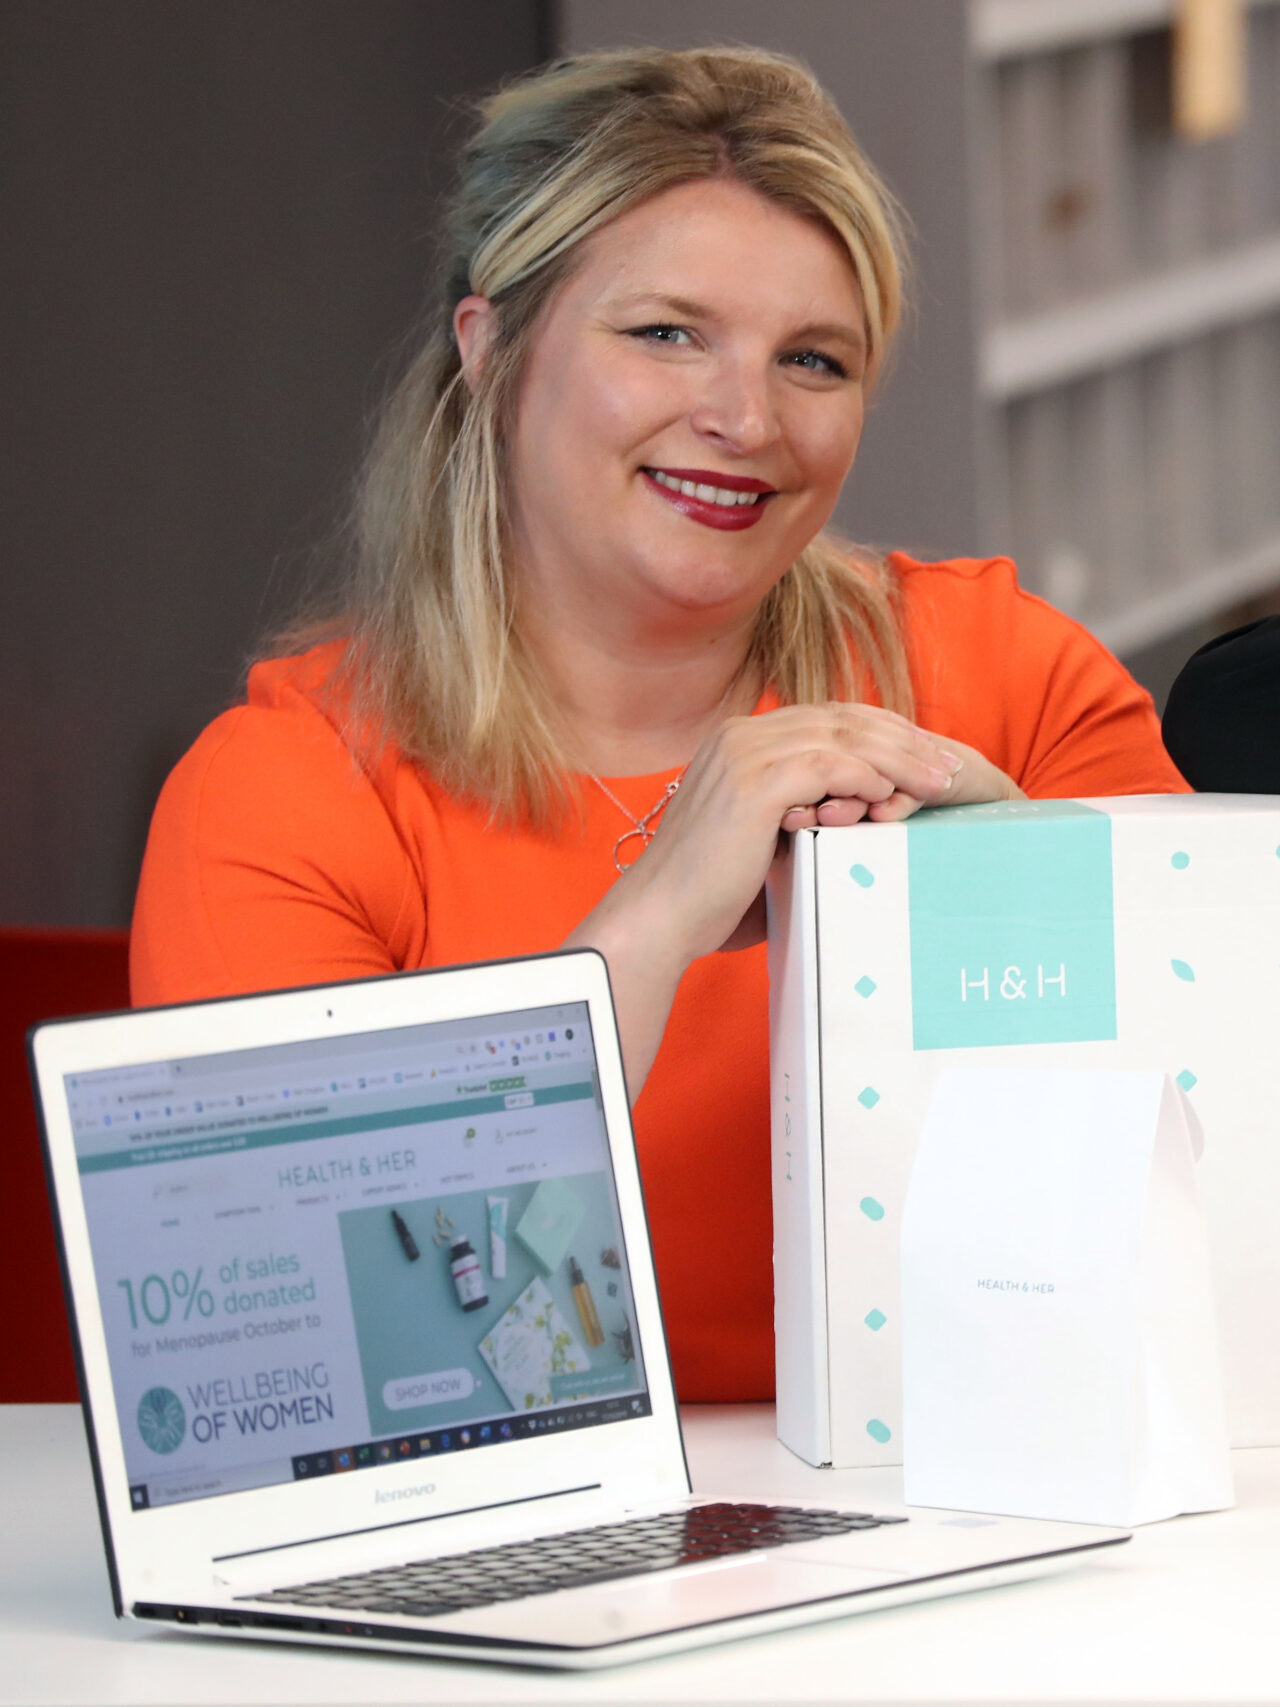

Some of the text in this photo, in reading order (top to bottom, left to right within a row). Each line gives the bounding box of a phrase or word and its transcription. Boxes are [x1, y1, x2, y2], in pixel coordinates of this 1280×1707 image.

[277, 1149, 416, 1189] HEALTH & HER
[219, 1253, 301, 1284] of sales
[977, 1279, 1020, 1291] HEALTH
[1031, 1283, 1056, 1295] HER
[117, 1265, 215, 1329] 10%
[223, 1277, 317, 1315] donated
[130, 1313, 321, 1359] for Menopause October to
[186, 1362, 330, 1410] WELLBEING
[394, 1378, 462, 1402] SHOP NOW
[192, 1393, 335, 1444] OF WOMEN
[374, 1483, 437, 1504] lenovo
